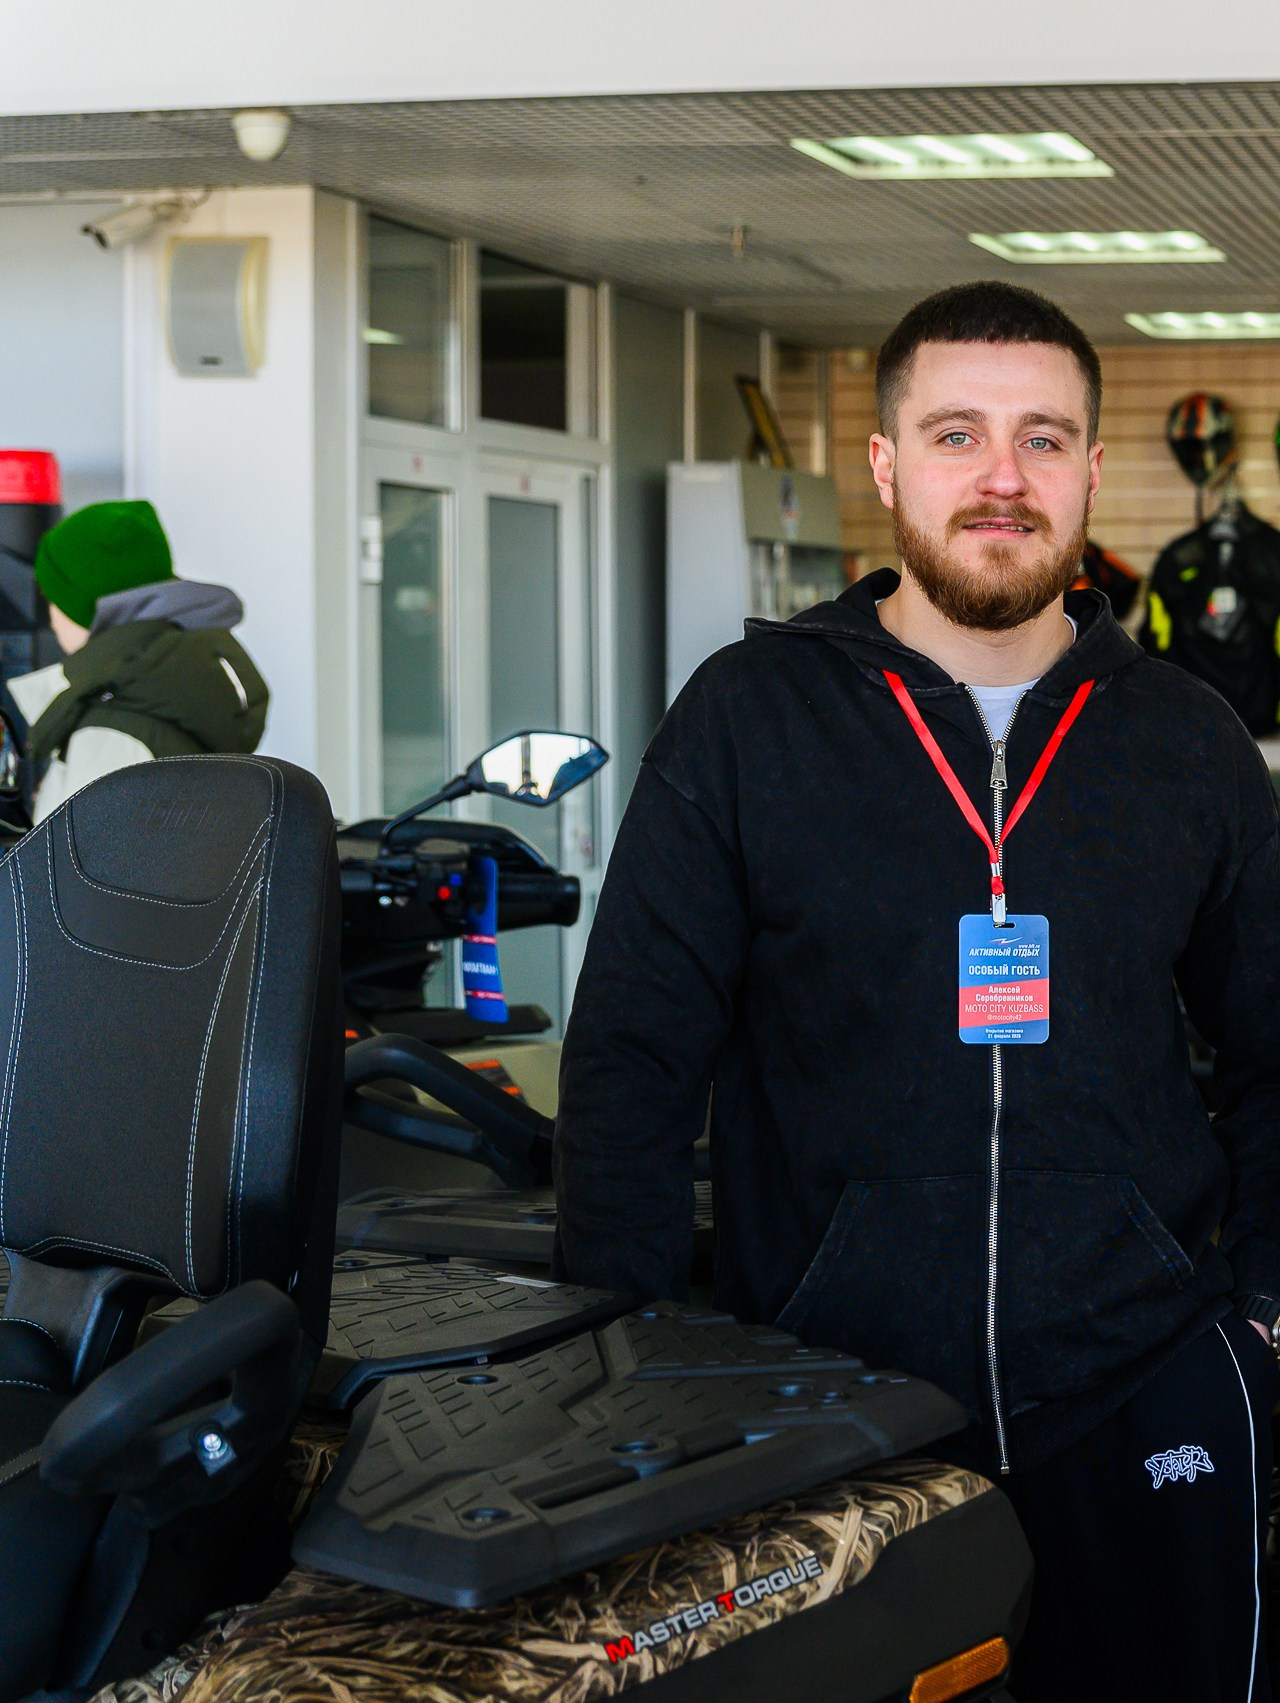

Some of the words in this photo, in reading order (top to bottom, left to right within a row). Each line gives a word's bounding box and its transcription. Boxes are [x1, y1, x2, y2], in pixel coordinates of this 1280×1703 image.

[969, 948, 1010, 957] АКТИВНЫЙ
[1012, 948, 1039, 957] ОТДЫХ
[968, 964, 1008, 976] ОСОБЫЙ
[1011, 965, 1040, 976] ГОСТЬ
[975, 994, 1034, 1004] Серебренников
[965, 1004, 988, 1013] MOTO
[989, 1004, 1007, 1013] CITY
[1008, 1004, 1044, 1013] KUZBASS
